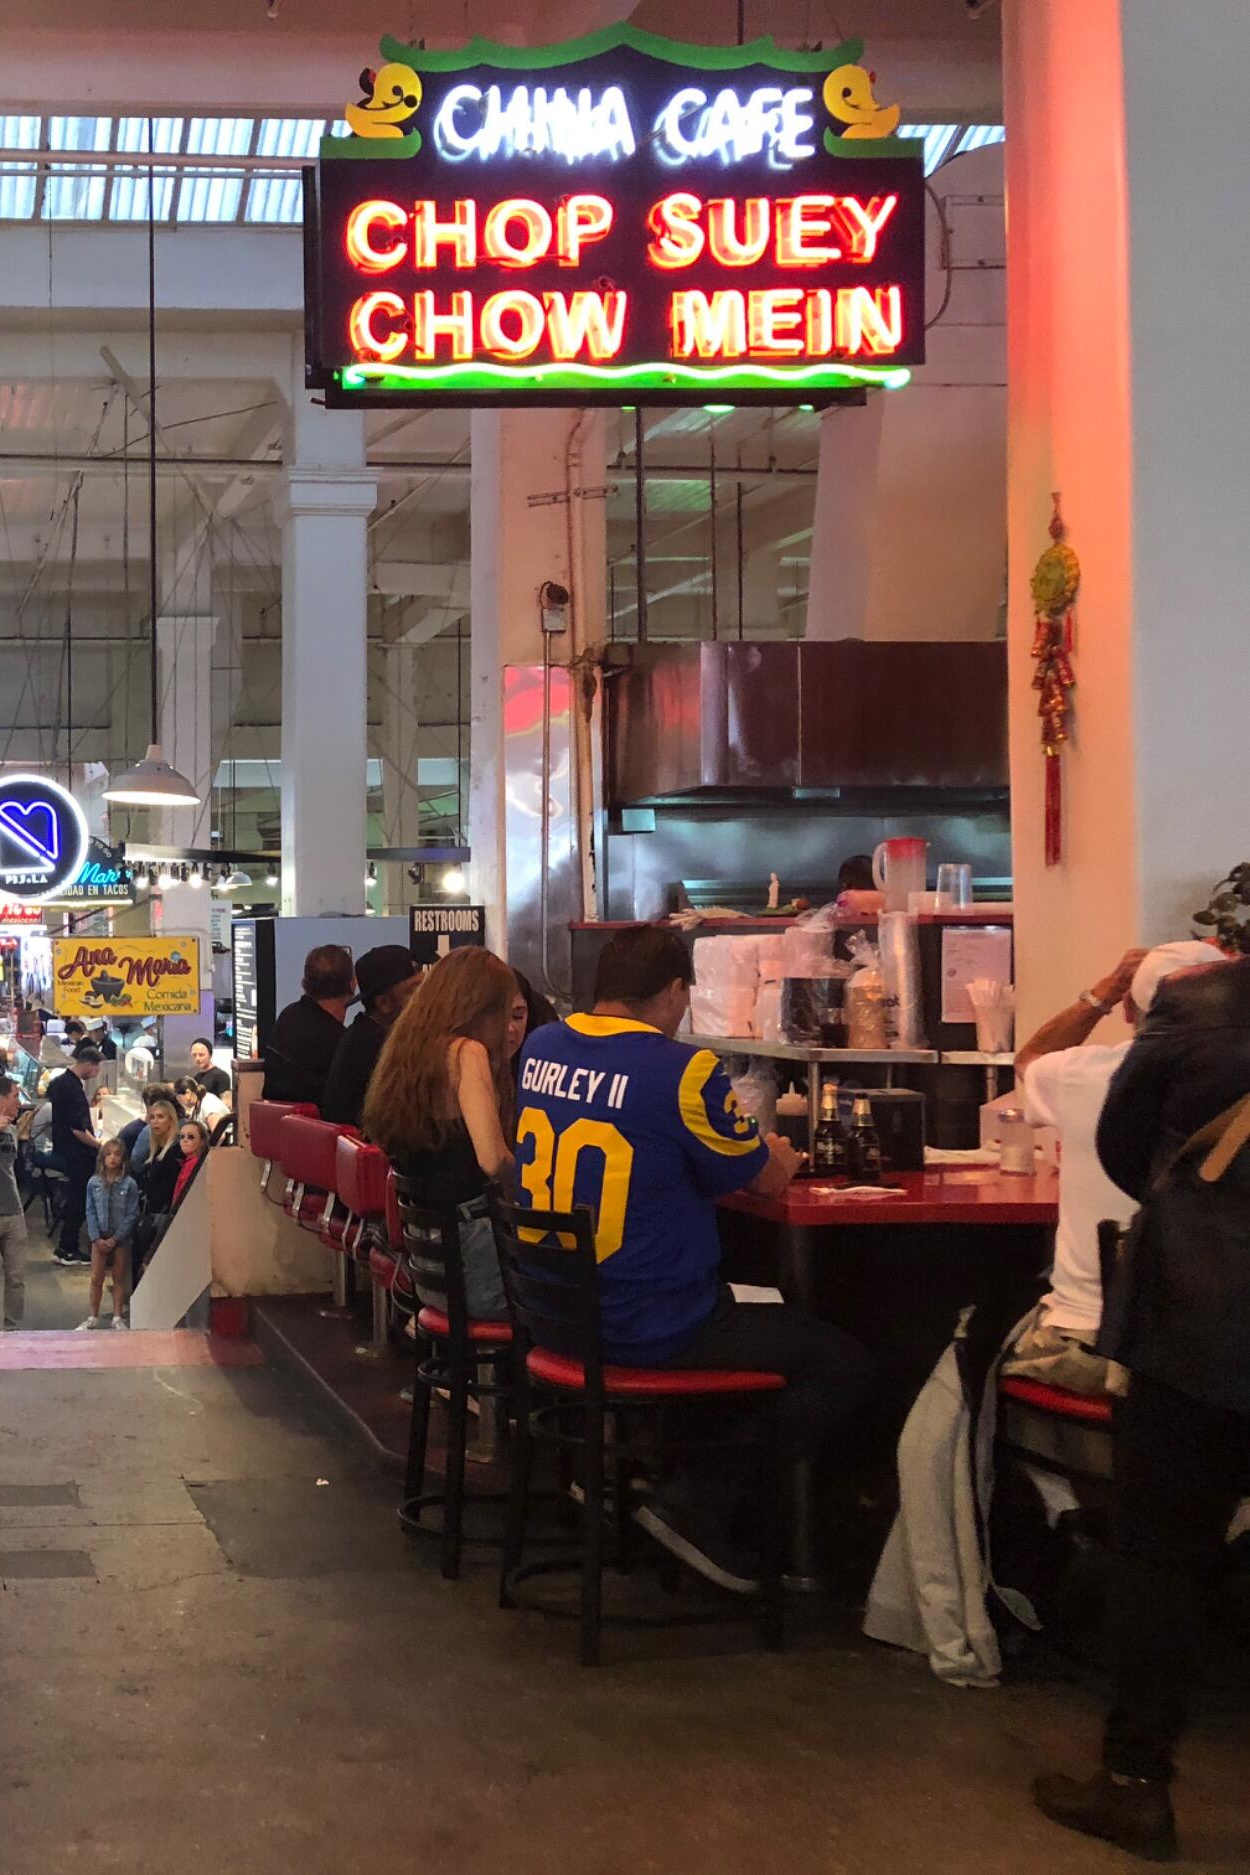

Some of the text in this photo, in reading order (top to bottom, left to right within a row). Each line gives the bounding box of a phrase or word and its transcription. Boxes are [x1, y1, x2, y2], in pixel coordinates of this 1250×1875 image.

[433, 84, 817, 169] CHINA CAFE
[346, 193, 897, 272] CHOP SUEY
[350, 286, 902, 362] CHOW MEIN
[88, 884, 99, 895] EN
[103, 884, 129, 895] TACOS
[414, 909, 479, 932] RESTROOMS
[58, 946, 192, 987] Ana Maria
[144, 1001, 192, 1012] Mexicana
[147, 988, 188, 1000] Comida
[521, 1057, 629, 1109] GURLEY II
[516, 1106, 634, 1264] 30
